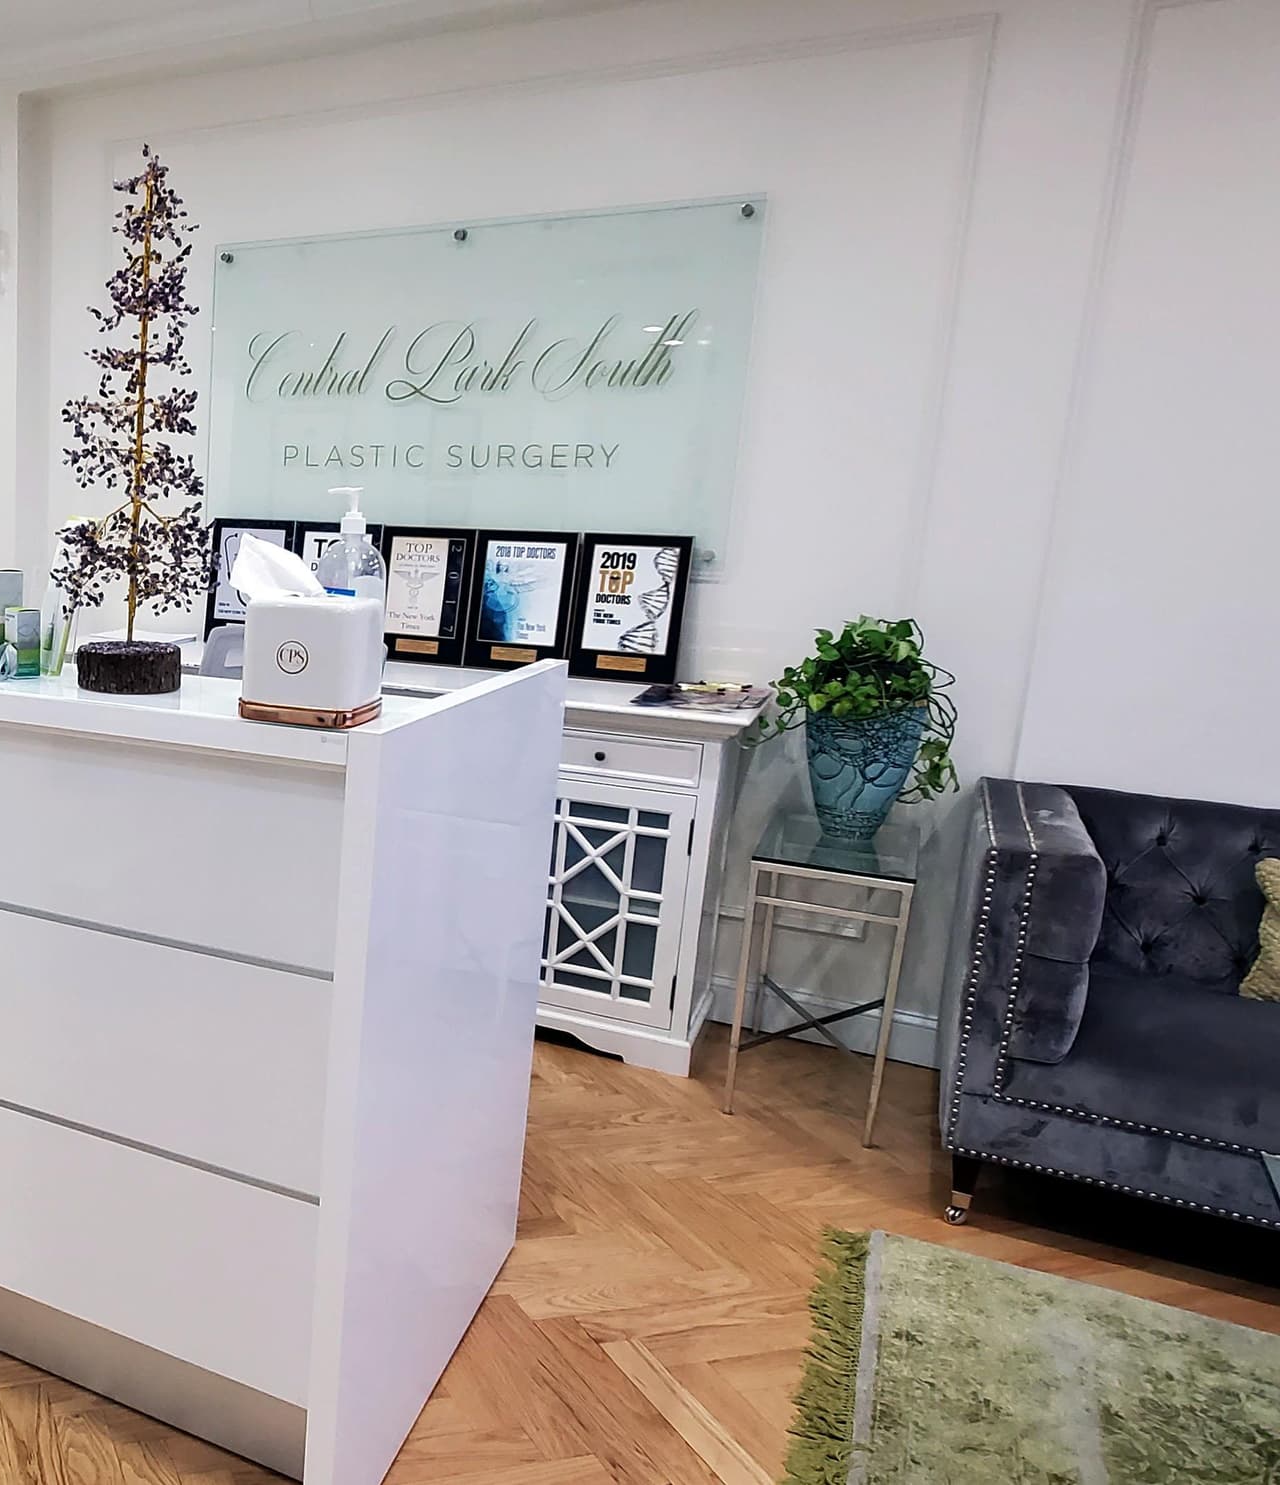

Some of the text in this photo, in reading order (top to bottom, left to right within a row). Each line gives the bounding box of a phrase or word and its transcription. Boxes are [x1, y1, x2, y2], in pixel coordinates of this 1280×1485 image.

[246, 307, 699, 404] Central Park South
[283, 443, 620, 468] PLASTIC SURGERY
[406, 542, 433, 554] TOP
[513, 546, 525, 559] TOP
[526, 547, 557, 560] DOCTORS
[396, 552, 441, 563] DOCTORS
[600, 551, 637, 570] 2019
[598, 569, 635, 594] TOP
[595, 593, 632, 605] DOCTORS
[279, 648, 305, 664] CPS
